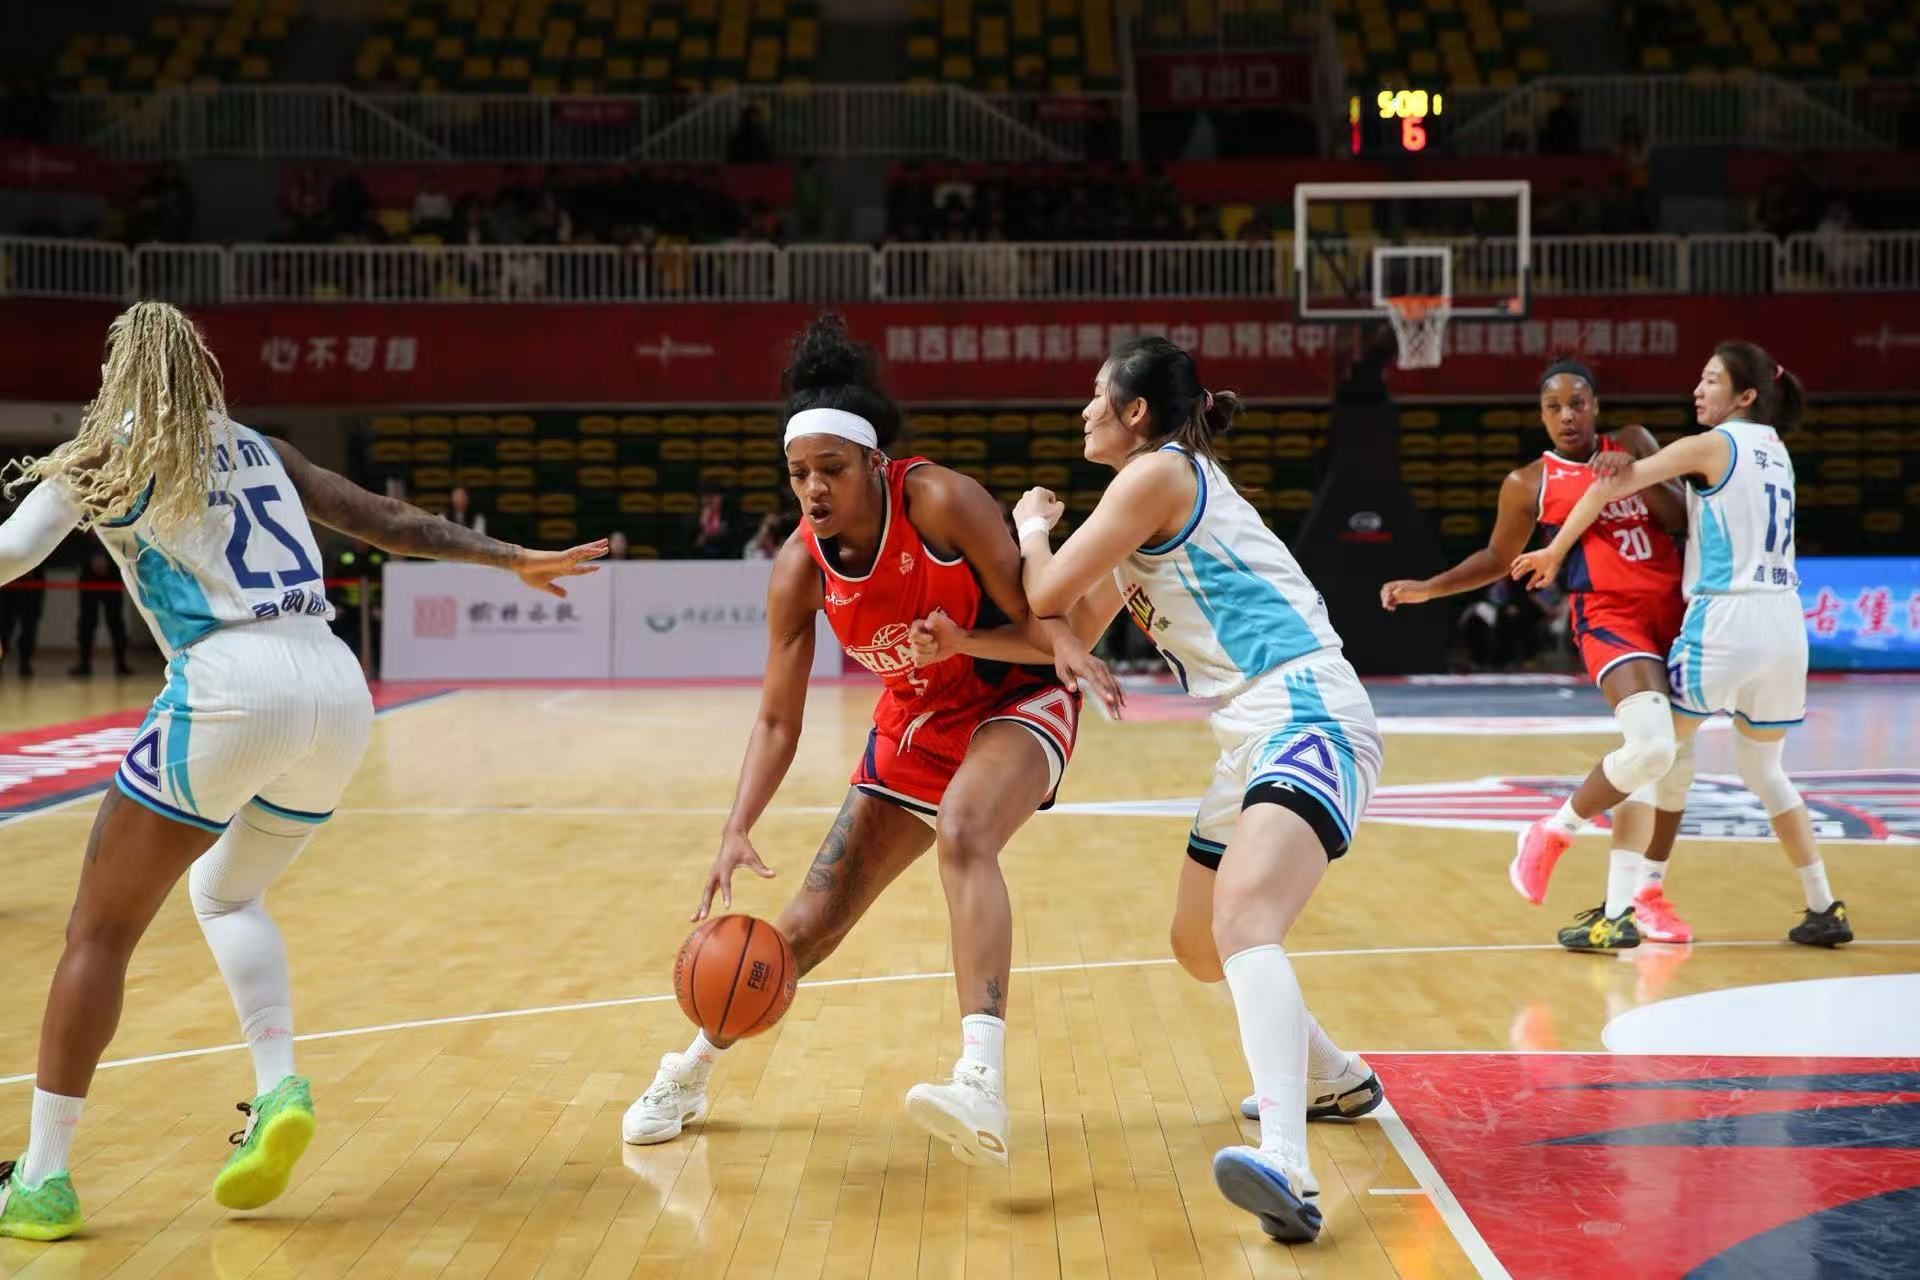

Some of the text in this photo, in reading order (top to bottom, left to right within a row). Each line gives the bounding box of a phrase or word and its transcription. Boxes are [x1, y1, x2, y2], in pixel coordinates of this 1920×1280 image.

[208, 485, 321, 589] 25
[1613, 526, 1652, 562] 20
[747, 961, 765, 990] FIBA
